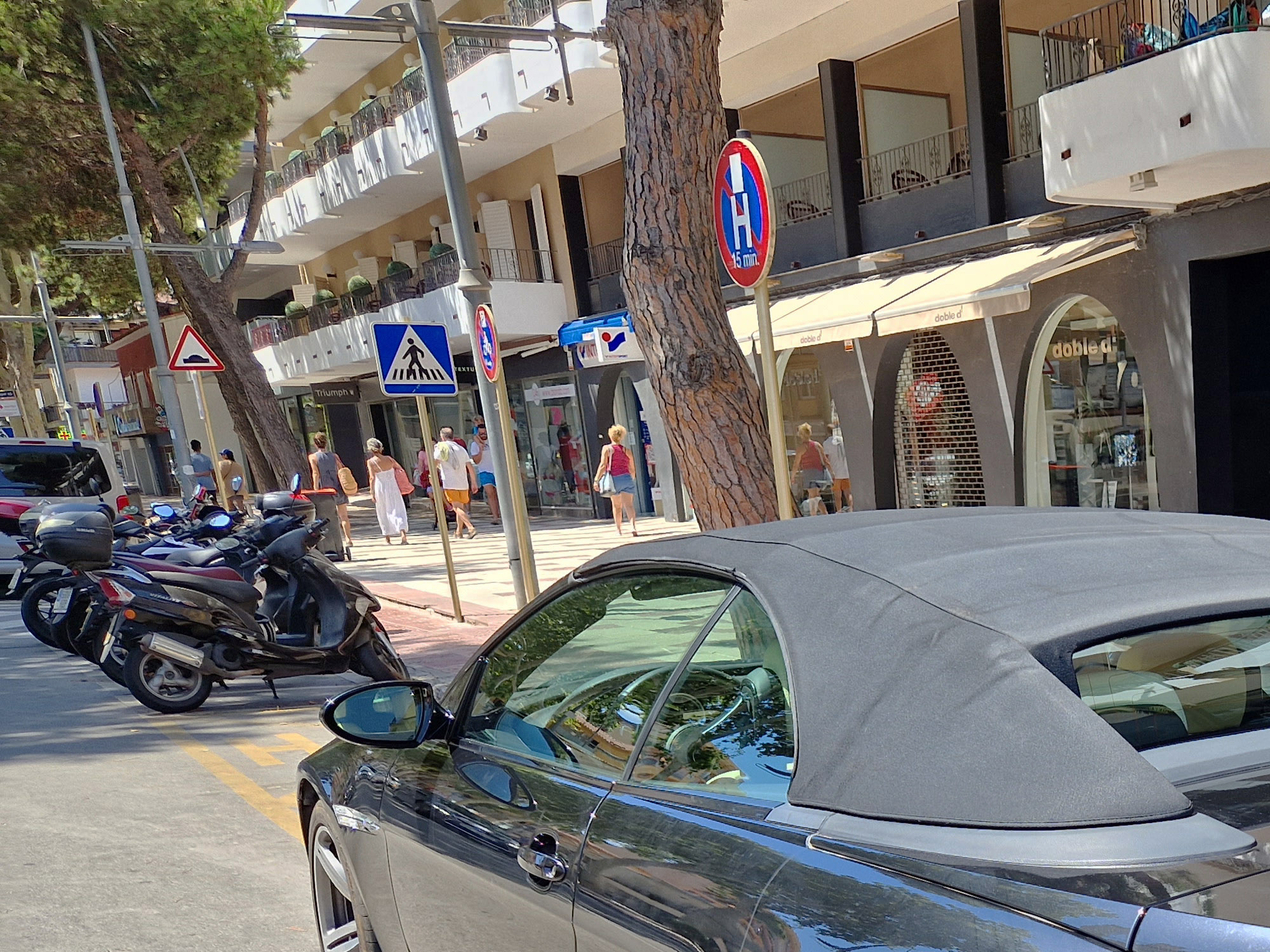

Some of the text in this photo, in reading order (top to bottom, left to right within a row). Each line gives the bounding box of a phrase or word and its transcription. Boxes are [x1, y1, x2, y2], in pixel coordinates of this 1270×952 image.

[731, 251, 742, 269] 15
[935, 311, 956, 323] doble
[800, 335, 817, 345] doble
[1052, 337, 1099, 358] doble
[315, 388, 349, 398] Triumph
